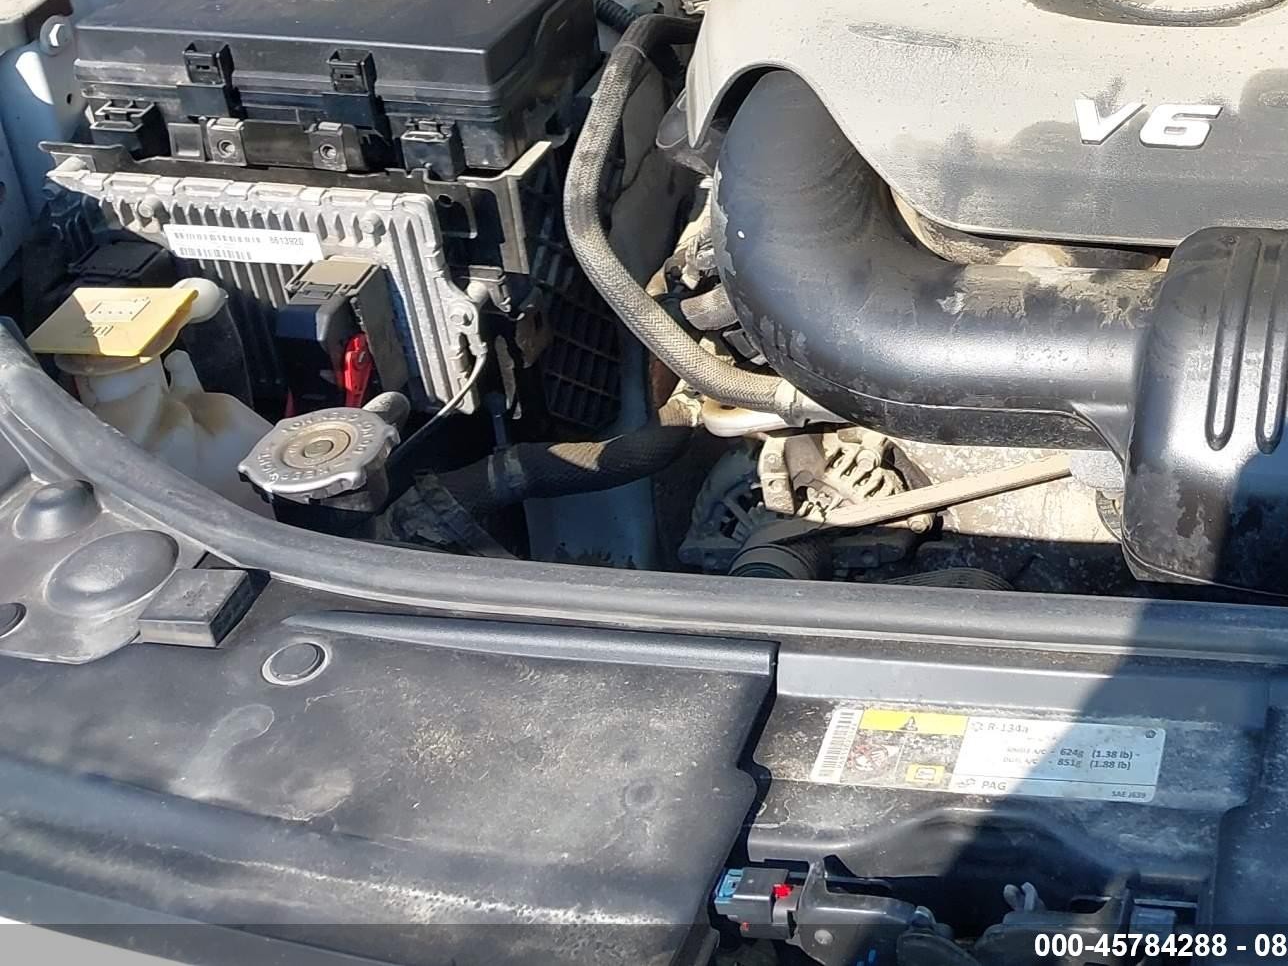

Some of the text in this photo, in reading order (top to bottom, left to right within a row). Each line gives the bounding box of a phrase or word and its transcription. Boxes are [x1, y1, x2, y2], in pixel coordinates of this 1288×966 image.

[1074, 97, 1224, 150] V6
[1059, 748, 1084, 758] 624g
[1091, 749, 1118, 760] (1.38
[1119, 750, 1133, 760] lb)
[1057, 758, 1081, 768] 851g
[1089, 759, 1115, 770] (1.88
[1116, 760, 1131, 770] lb)
[981, 780, 1007, 791] PAG
[1111, 790, 1126, 798] SAE
